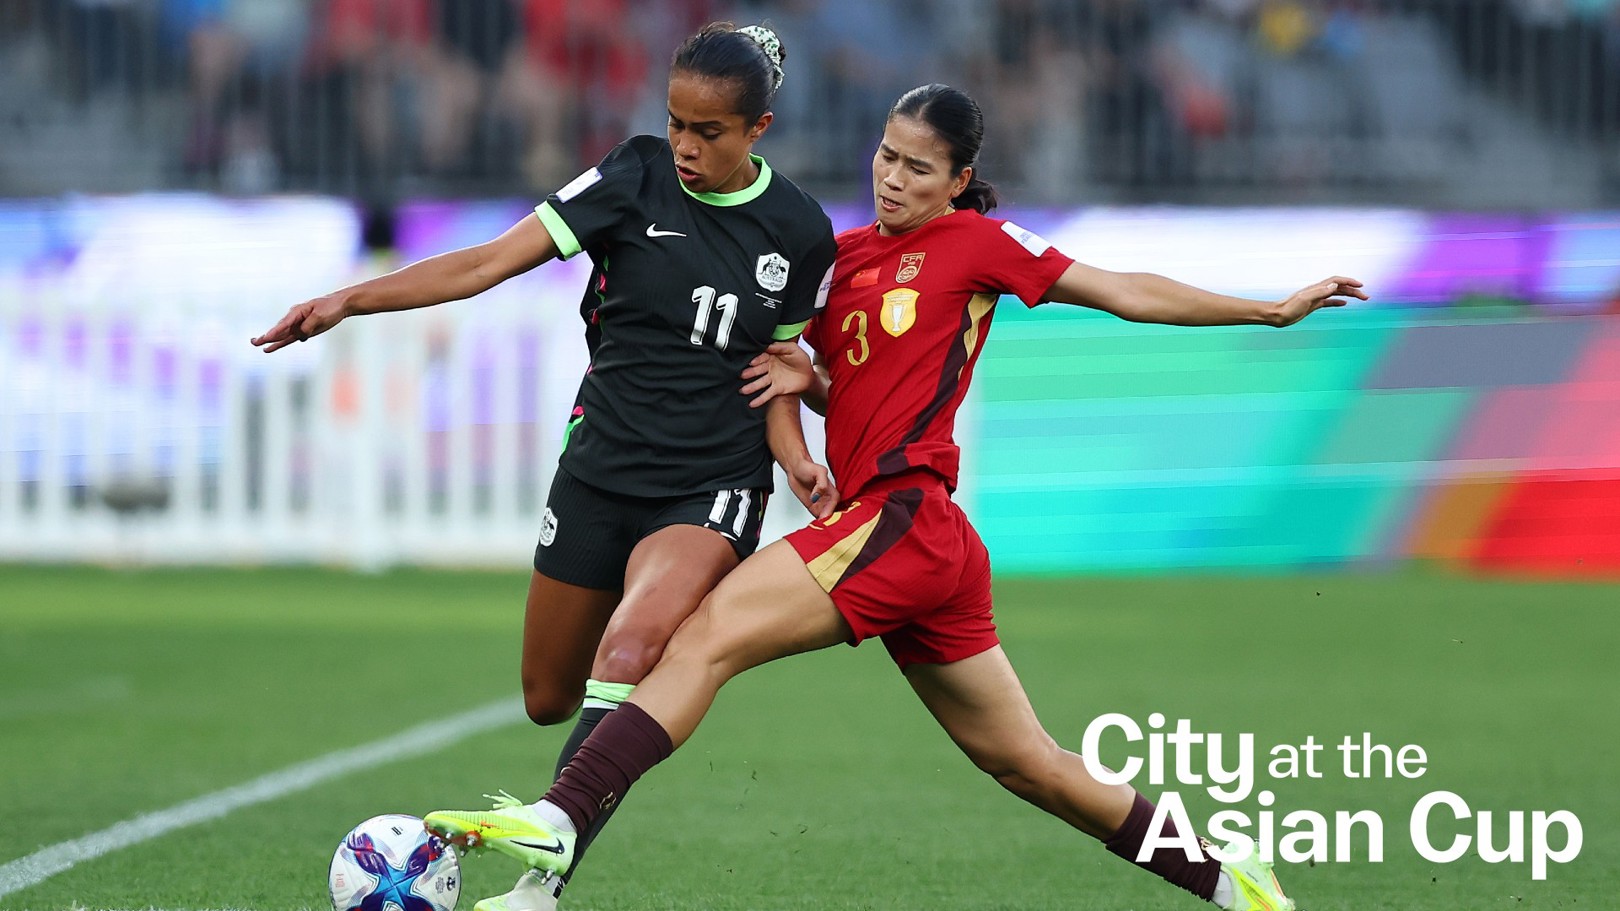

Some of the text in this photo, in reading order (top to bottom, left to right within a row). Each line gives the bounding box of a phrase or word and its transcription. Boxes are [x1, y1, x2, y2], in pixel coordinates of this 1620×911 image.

[690, 285, 739, 351] 11
[841, 309, 870, 366] 3
[708, 488, 752, 538] 11
